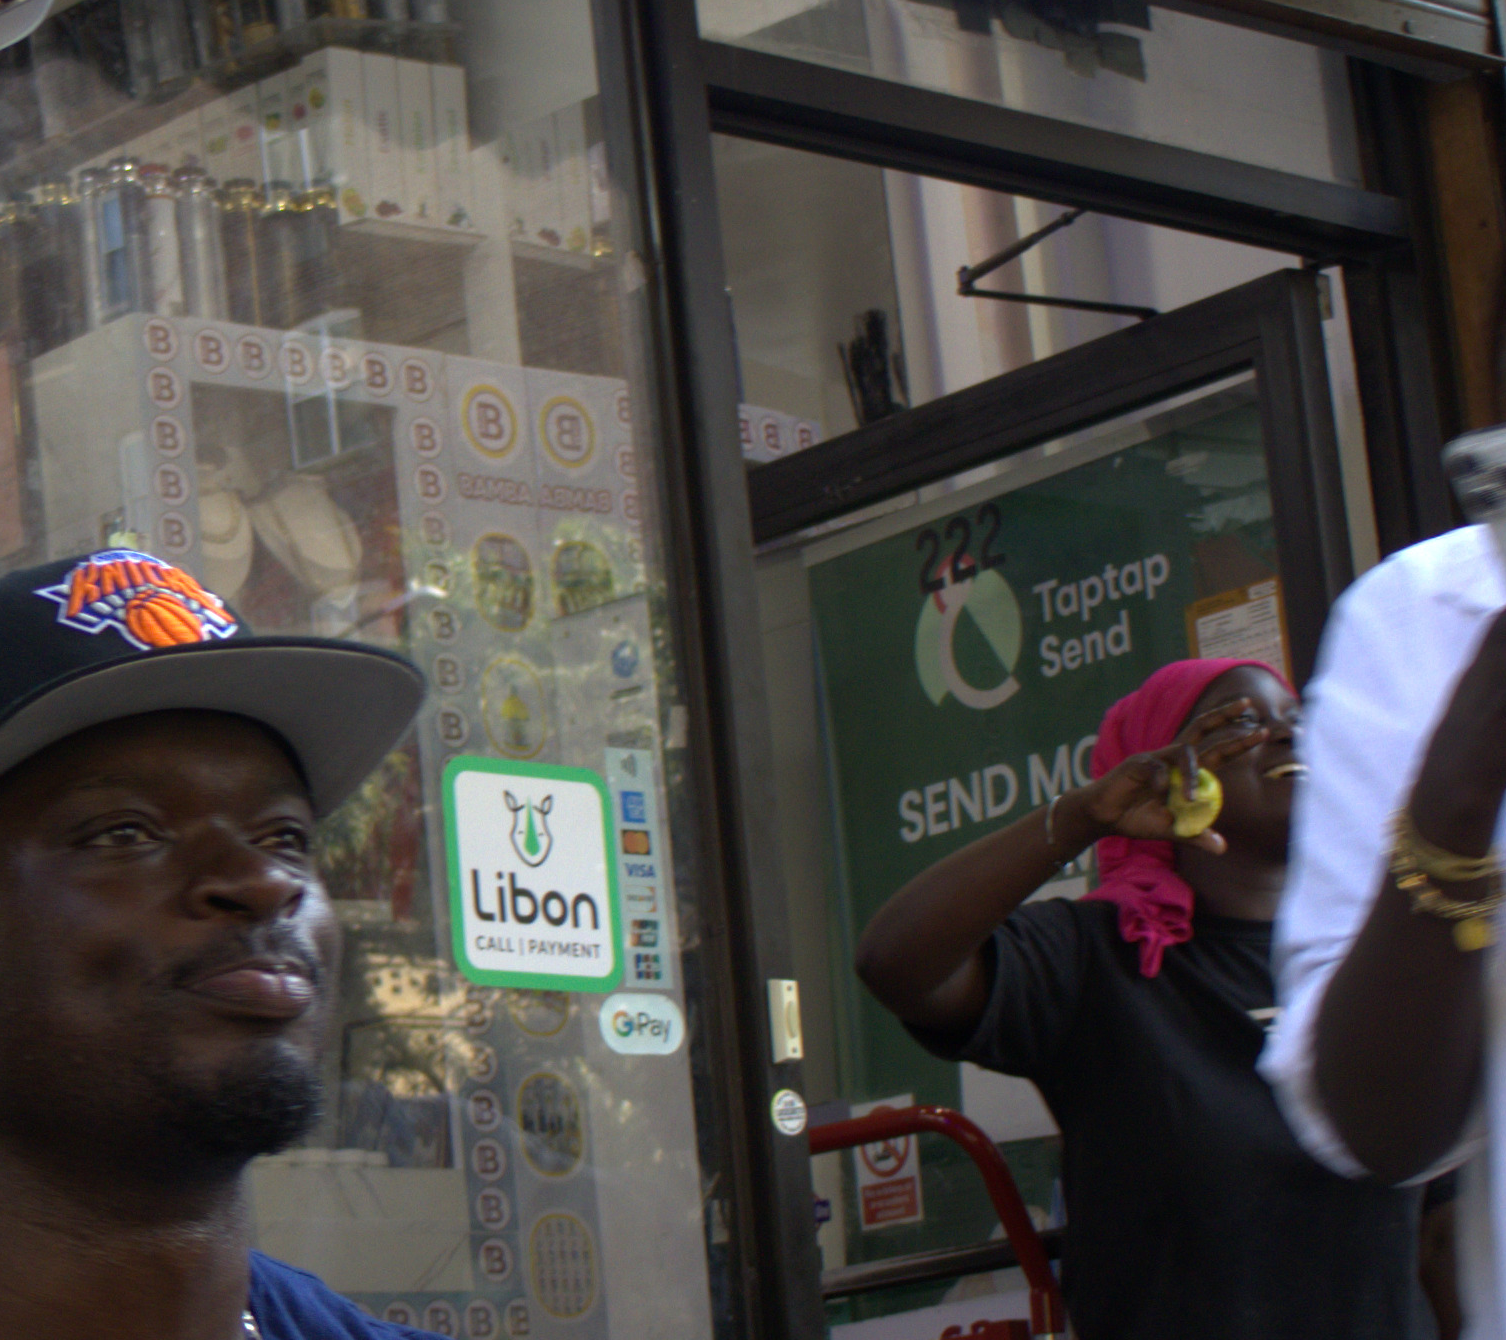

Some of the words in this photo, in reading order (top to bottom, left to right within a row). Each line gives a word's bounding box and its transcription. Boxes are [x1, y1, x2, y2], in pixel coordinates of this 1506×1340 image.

[476, 401, 504, 441] B
[915, 501, 1006, 595] 222
[1032, 553, 1171, 624] Taptap
[1039, 610, 1133, 679] Send
[898, 764, 1020, 845] SEND
[470, 868, 601, 931] Libon
[625, 862, 657, 879] VISA
[475, 934, 516, 954] CALL
[528, 938, 602, 960] PAYMENT
